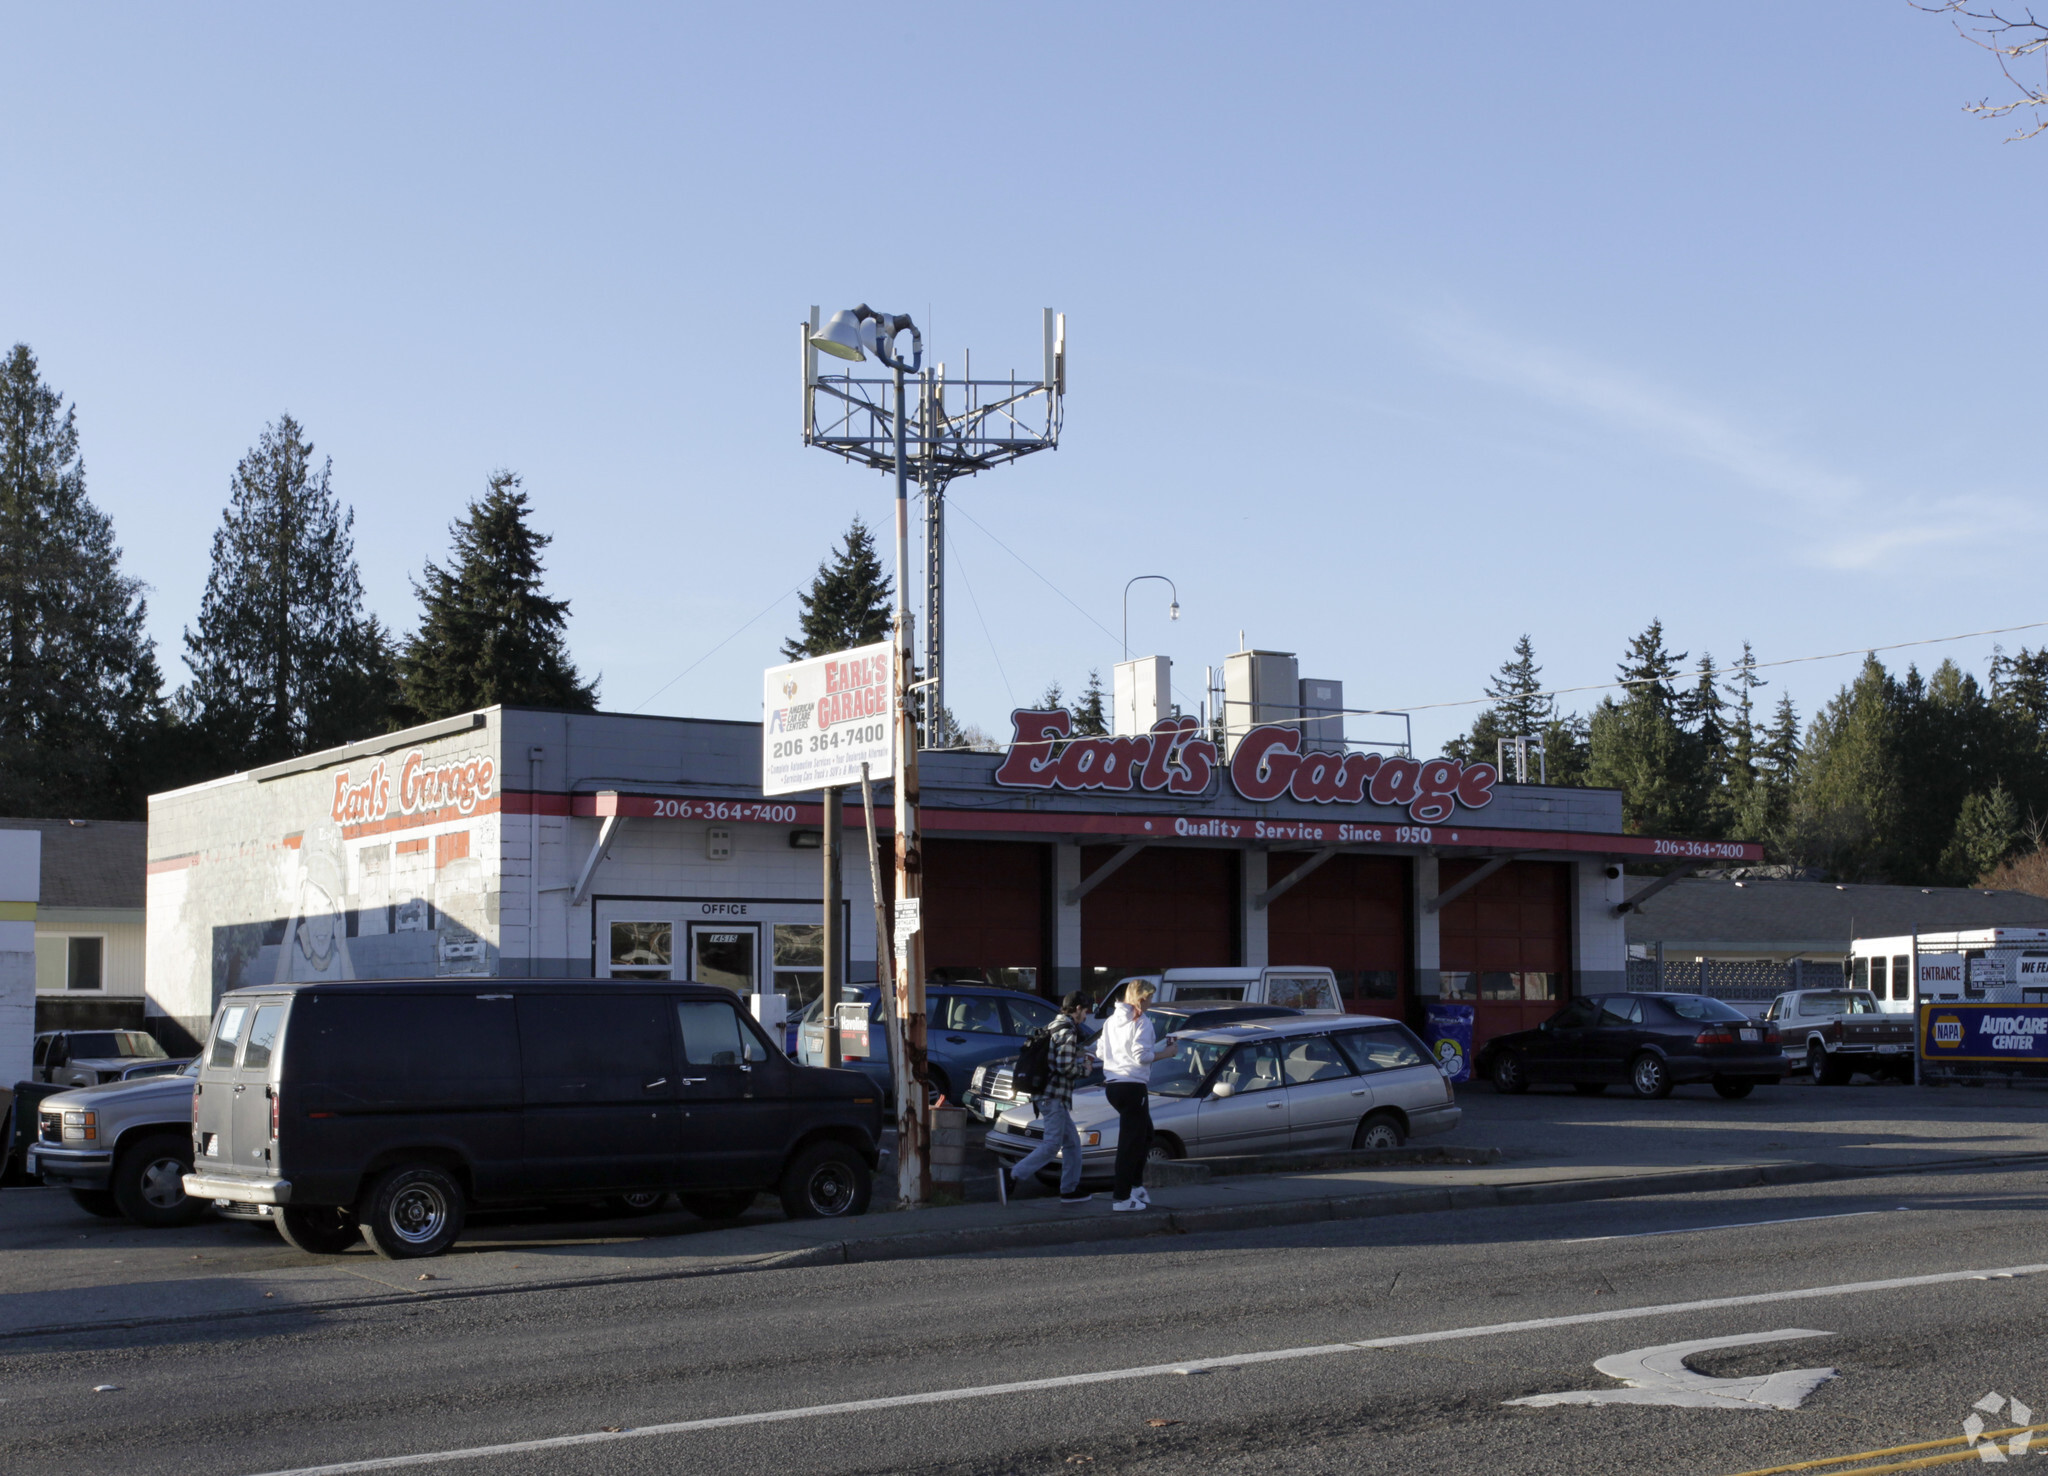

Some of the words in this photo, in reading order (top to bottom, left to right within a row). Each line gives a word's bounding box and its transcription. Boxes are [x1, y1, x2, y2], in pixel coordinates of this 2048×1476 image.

[825, 654, 888, 695] EARL'S
[788, 702, 815, 714] AMERICAN
[817, 685, 888, 731] GARAGE
[787, 713, 798, 723] CAR
[798, 710, 812, 722] CARE
[785, 720, 809, 732] CENTERS
[773, 738, 803, 759] 206
[809, 723, 884, 752] 364-7400
[994, 708, 1218, 795] Earl's
[1231, 725, 1498, 825] Garage
[331, 758, 390, 826] Earl's
[399, 749, 494, 815] Garage
[1174, 817, 1241, 839] Quality
[1254, 820, 1323, 839] Service
[1338, 824, 1382, 842] Since
[1395, 827, 1432, 844] 1950
[701, 903, 748, 915] OFFICE
[711, 934, 738, 943] 14515
[1921, 966, 1961, 981] ENTRANCE
[2021, 962, 2036, 973] WE
[841, 1016, 868, 1031] Havoline
[1937, 1024, 1959, 1040] NAPA
[1992, 1035, 2034, 1050] CENTER
